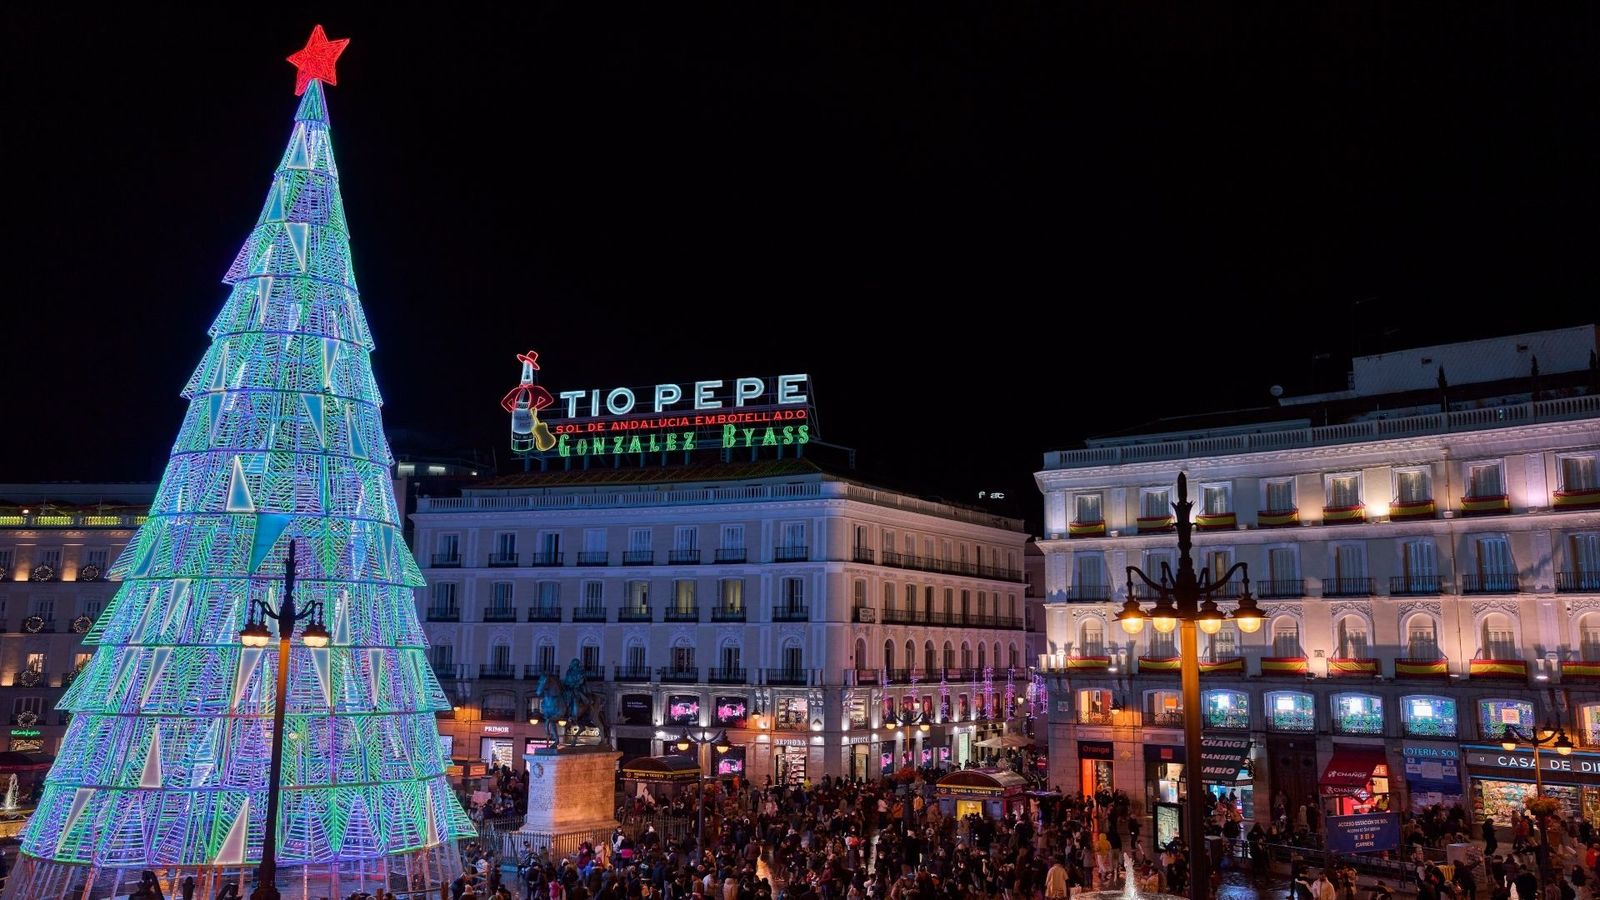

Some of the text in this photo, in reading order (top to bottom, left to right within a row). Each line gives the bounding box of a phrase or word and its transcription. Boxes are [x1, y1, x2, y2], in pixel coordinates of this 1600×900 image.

[560, 374, 807, 418] TIO PEPE
[556, 410, 806, 434] SOL DE ANDALUCIA EMBOTELLADO
[1201, 740, 1248, 748] CHANGE
[1083, 745, 1109, 754] Orange
[1403, 747, 1457, 757] LOTERIA SOL
[1201, 753, 1241, 761] RANSFER
[1498, 756, 1536, 767] CASA
[1550, 760, 1571, 770] DE
[1202, 766, 1235, 774] MBIO
